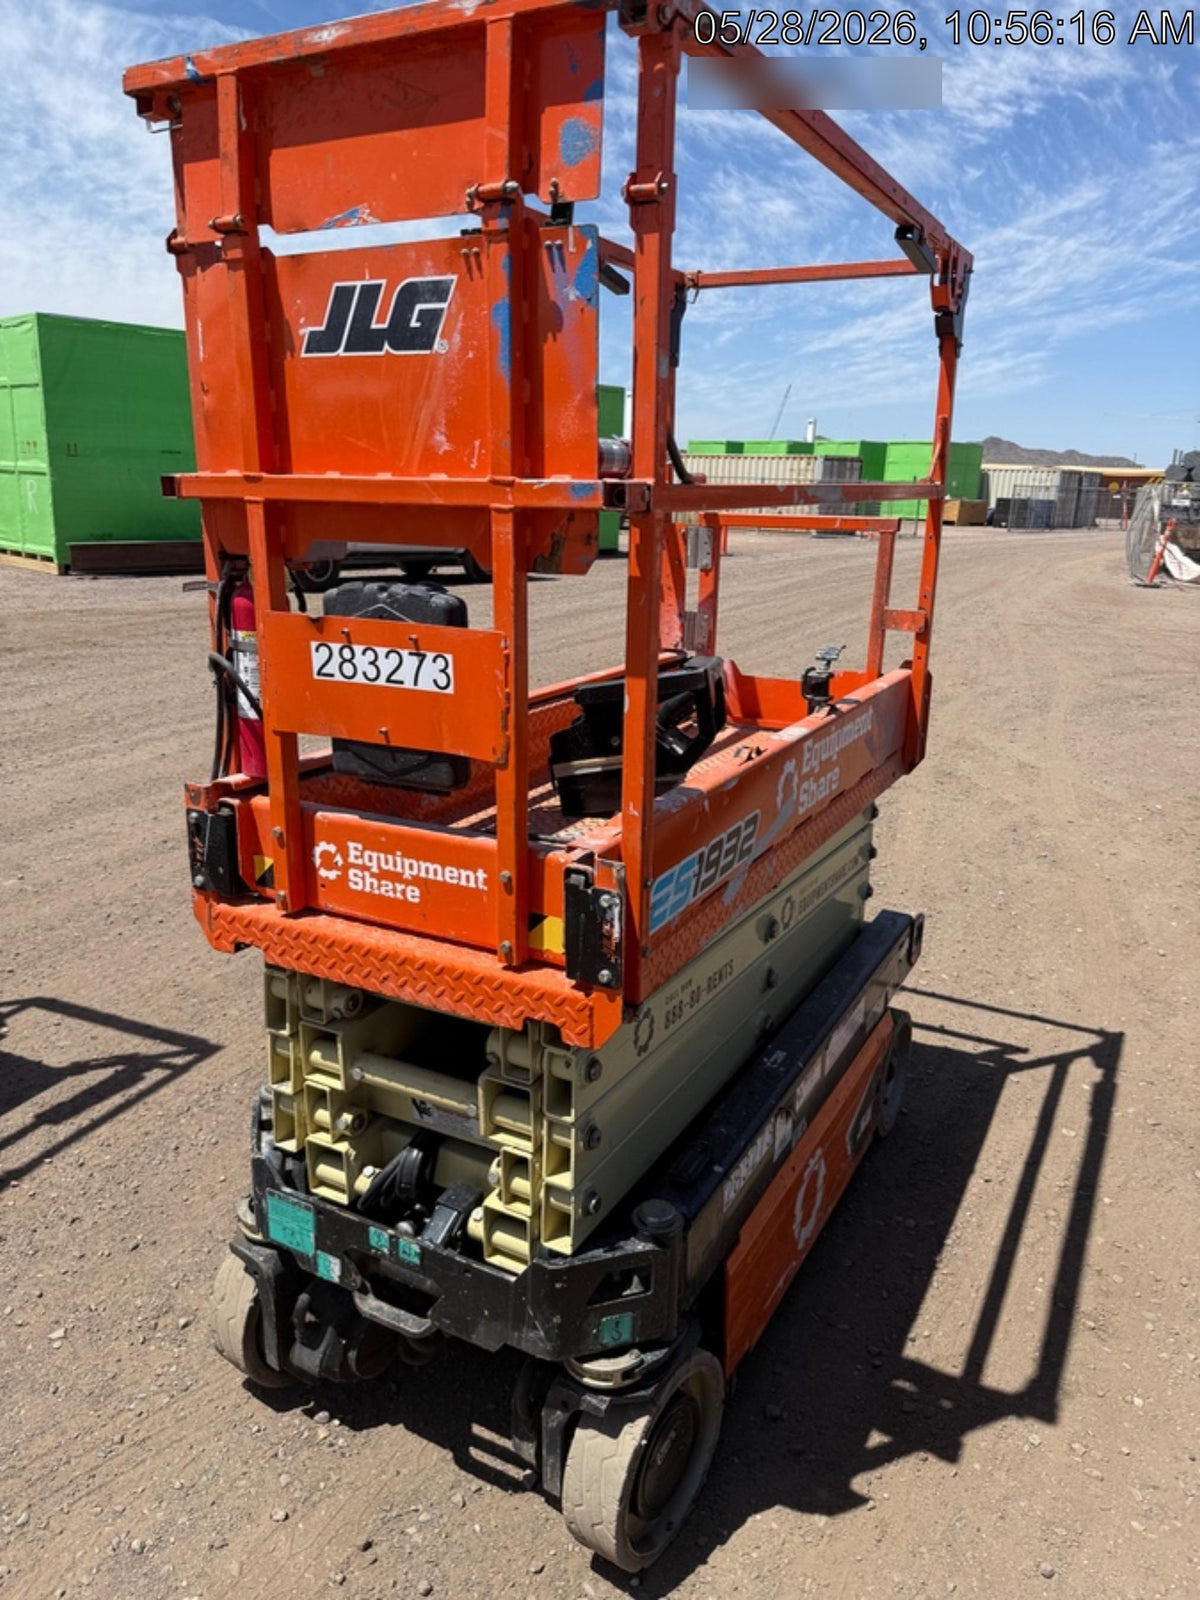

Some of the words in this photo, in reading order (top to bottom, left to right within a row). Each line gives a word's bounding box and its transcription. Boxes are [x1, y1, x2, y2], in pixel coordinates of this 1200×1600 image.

[301, 275, 457, 357] JLG
[314, 642, 451, 691] 283273
[801, 705, 873, 775] Equipment
[798, 767, 840, 814] Share
[347, 840, 488, 892] Equipment
[347, 869, 421, 903] Share
[649, 809, 761, 935] ES1932
